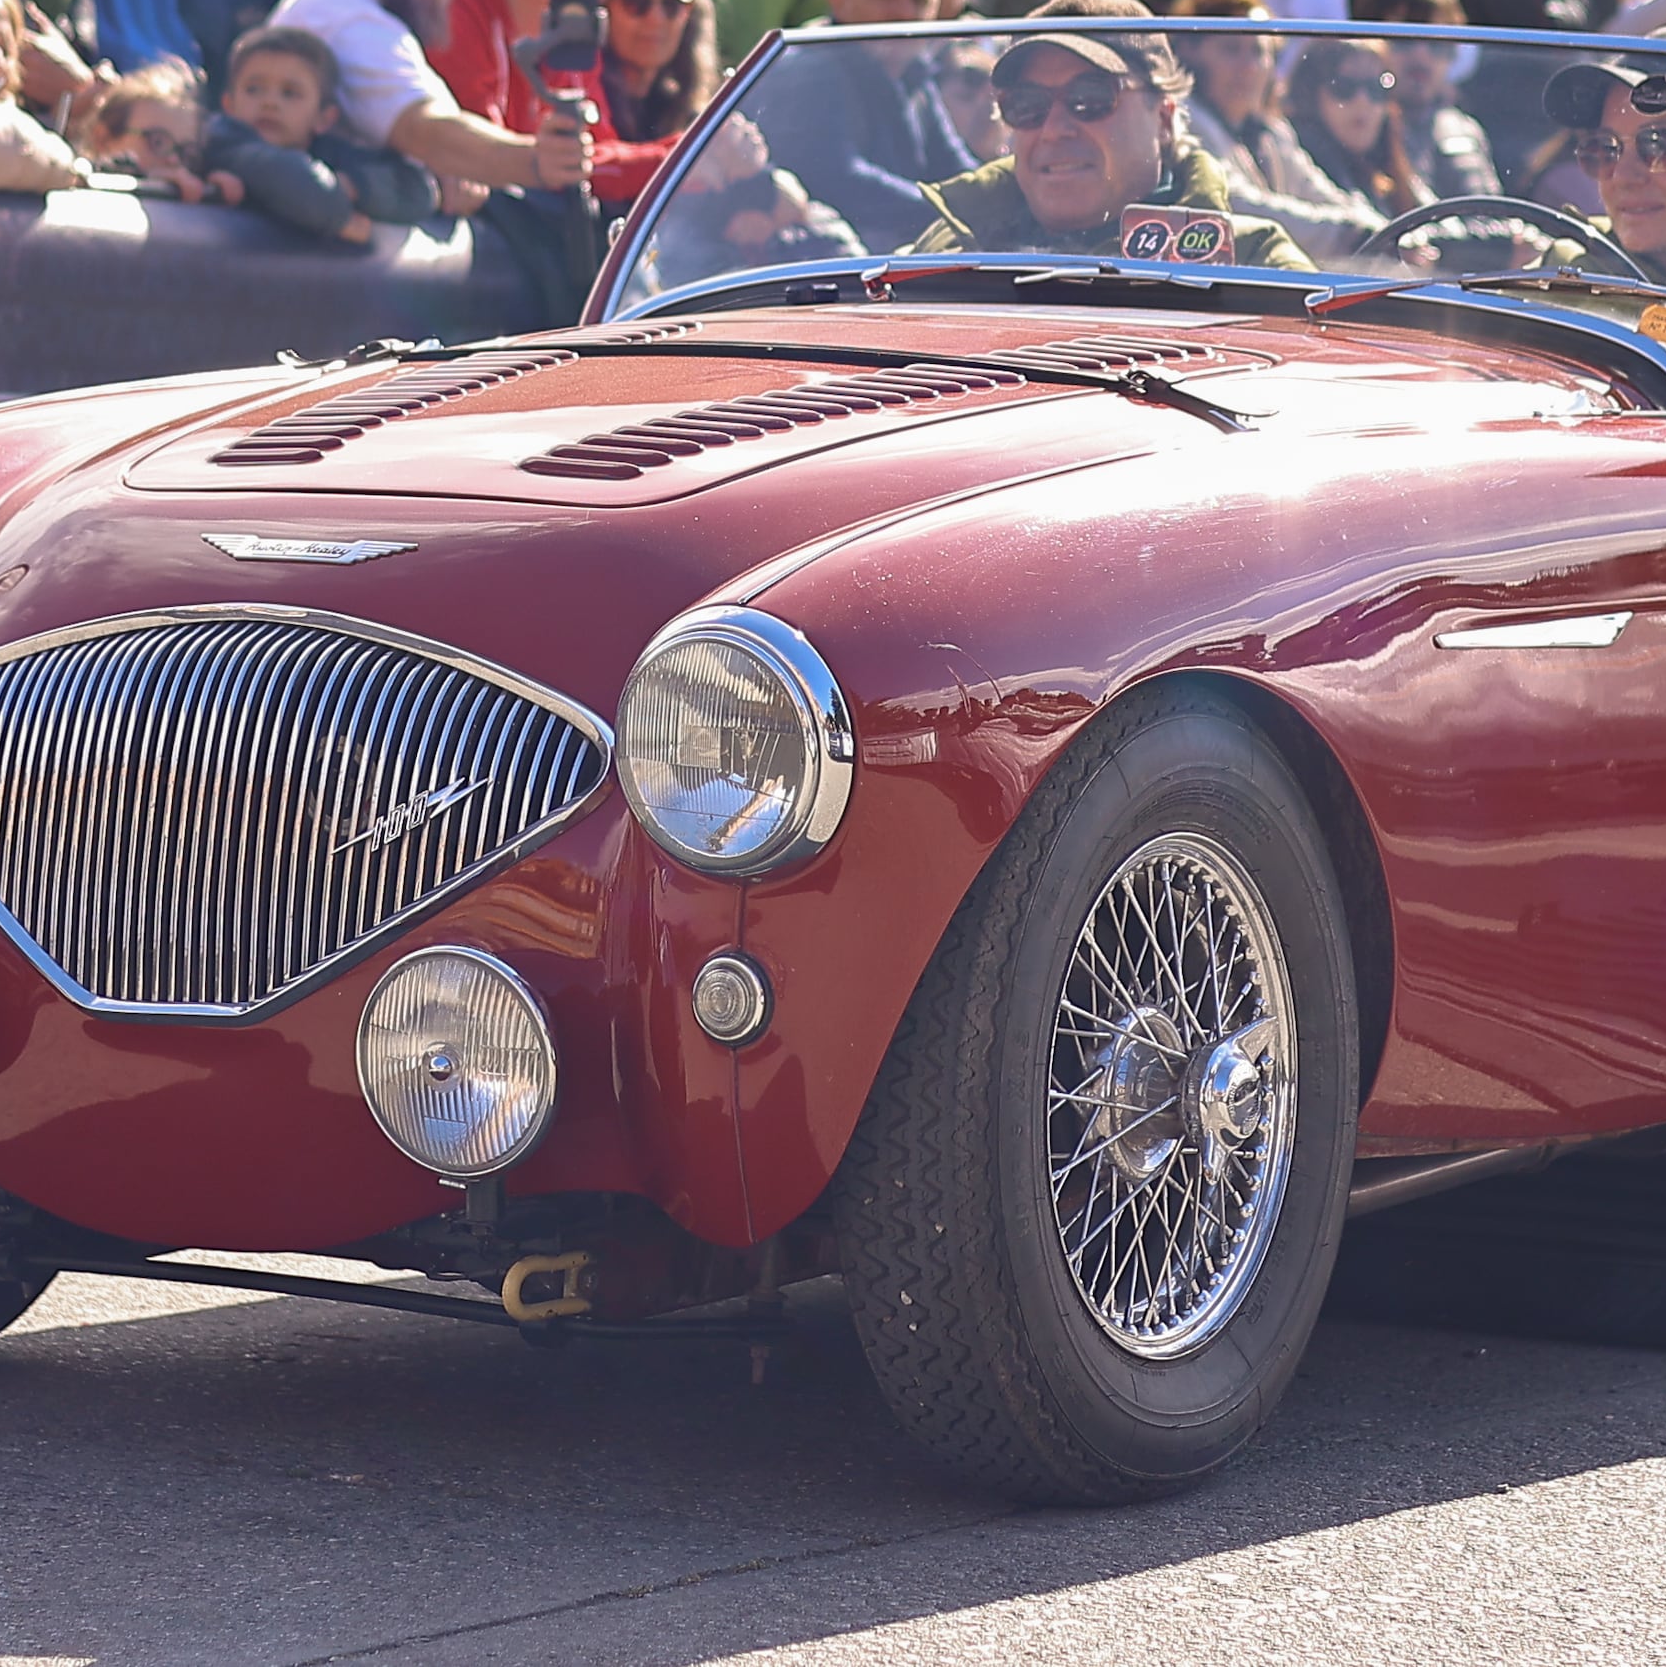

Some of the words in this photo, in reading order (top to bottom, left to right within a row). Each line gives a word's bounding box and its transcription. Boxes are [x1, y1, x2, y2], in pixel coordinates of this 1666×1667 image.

[1136, 231, 1160, 251] 14
[1182, 232, 1214, 249] OK
[371, 789, 429, 853] 100
